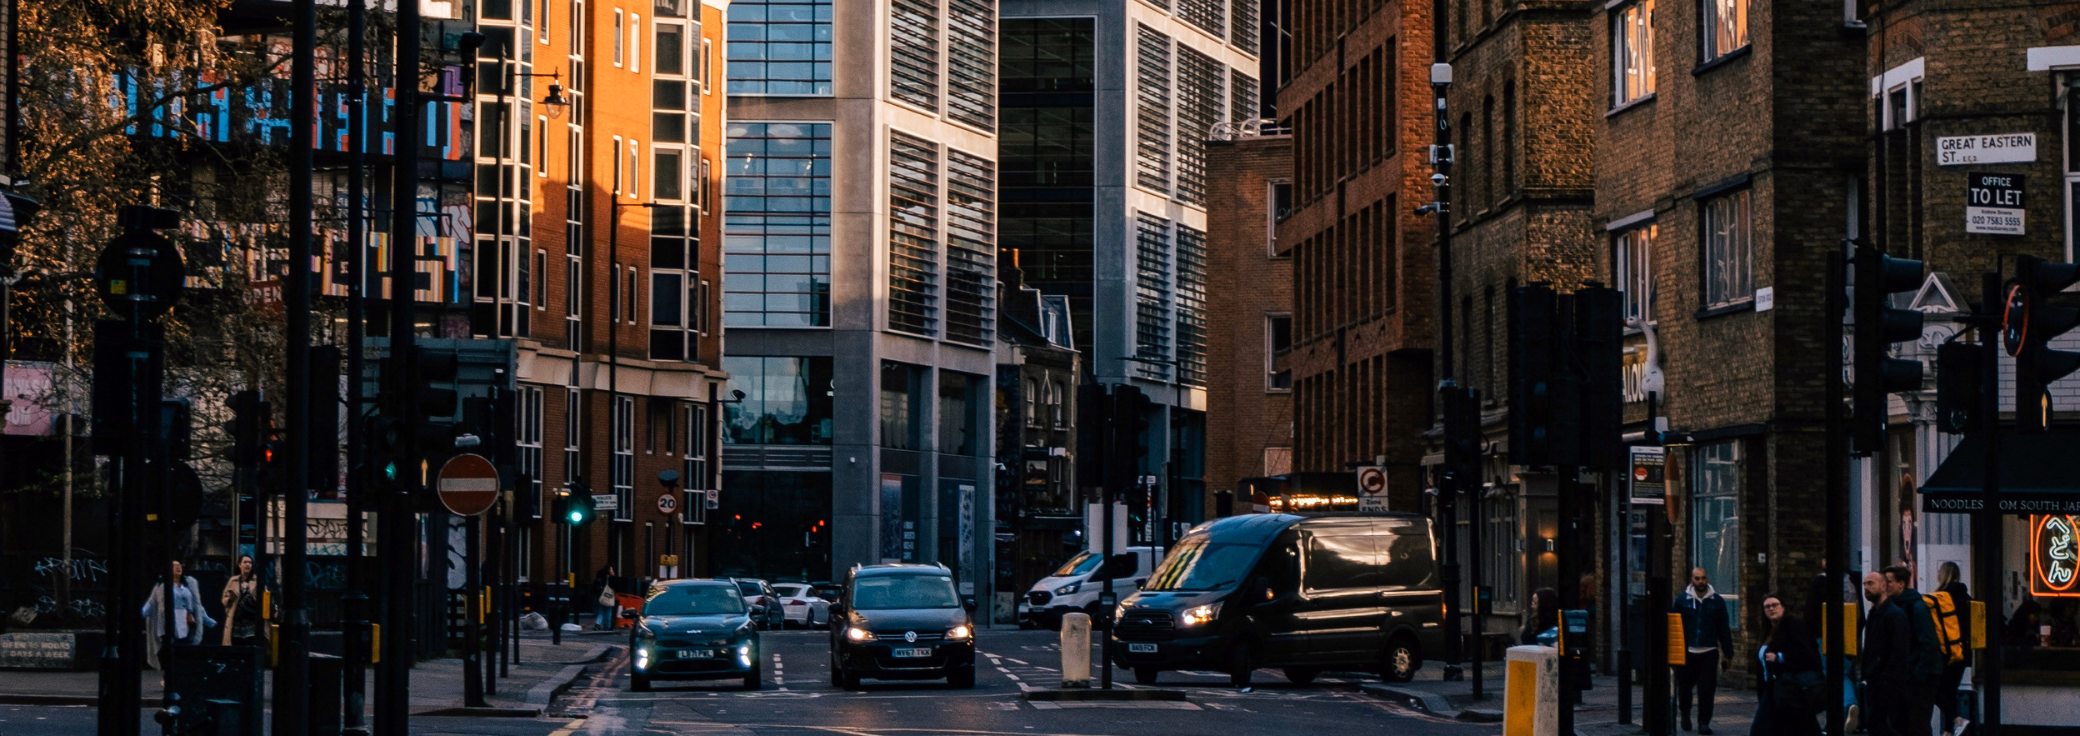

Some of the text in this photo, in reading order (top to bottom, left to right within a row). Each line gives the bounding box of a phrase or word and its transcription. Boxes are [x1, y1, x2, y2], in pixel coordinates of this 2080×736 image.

[1942, 136, 2032, 150] GREAT EASTERN
[1942, 151, 1960, 163] ST.
[1982, 176, 2012, 187] OFFICE
[1971, 188, 2022, 205] TO LET
[1972, 215, 2020, 226] 020 7583 5555
[242, 285, 282, 305] OPEN
[660, 498, 675, 509] 20
[1931, 499, 1984, 510] NOODLES
[1999, 500, 2017, 510] OM
[2020, 500, 2060, 511] SOUTH
